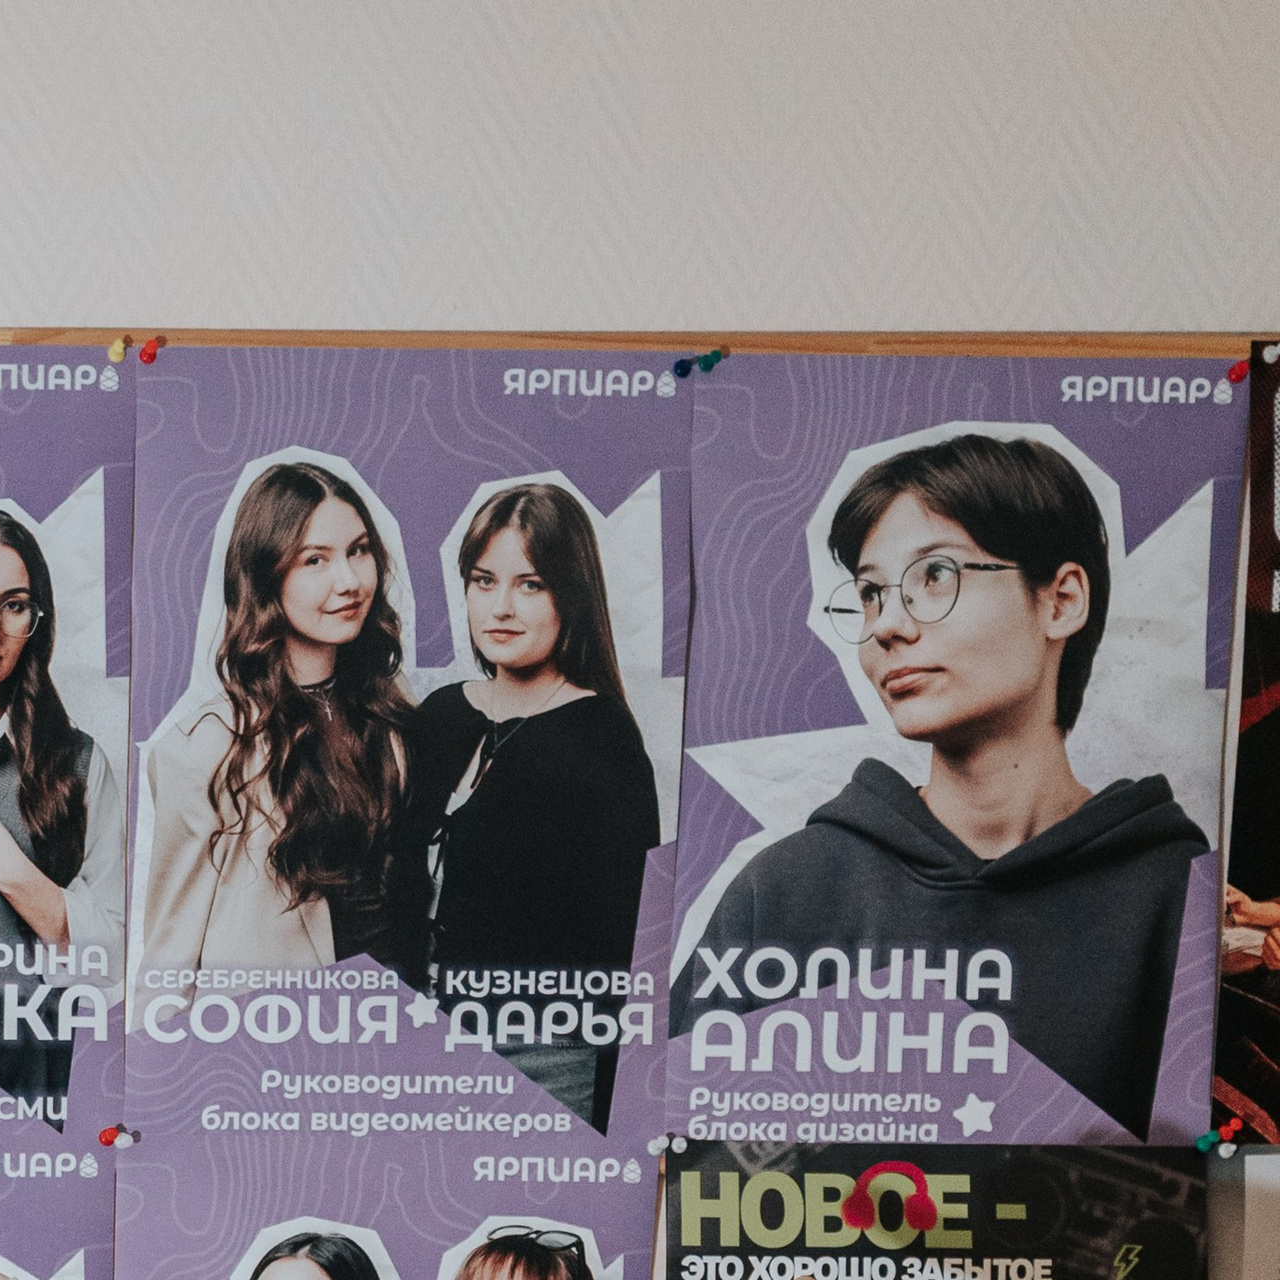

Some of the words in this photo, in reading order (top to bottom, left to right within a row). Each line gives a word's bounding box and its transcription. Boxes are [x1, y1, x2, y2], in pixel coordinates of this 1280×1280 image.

[503, 368, 655, 397] ЯРПИАР
[1060, 375, 1212, 404] ЯРПИАР
[144, 969, 399, 990] СЕРЕБРЕННИКОВА
[445, 970, 654, 999] КУЗНЕЦОВА
[694, 947, 1013, 1001] ХОЛИНА
[143, 994, 398, 1044] СОФИЯ
[445, 1000, 653, 1053] ДАРЬЯ
[690, 1010, 1009, 1074] АЛИНА
[261, 1069, 514, 1100] Руководители
[689, 1087, 941, 1117] Руководитель
[201, 1104, 300, 1132] блока
[310, 1106, 572, 1138] видеомейкеров
[688, 1115, 786, 1141] блока
[797, 1117, 939, 1143] дизайна
[473, 1155, 621, 1183] ЯРПИАР
[680, 1171, 973, 1250] НОВОЕ
